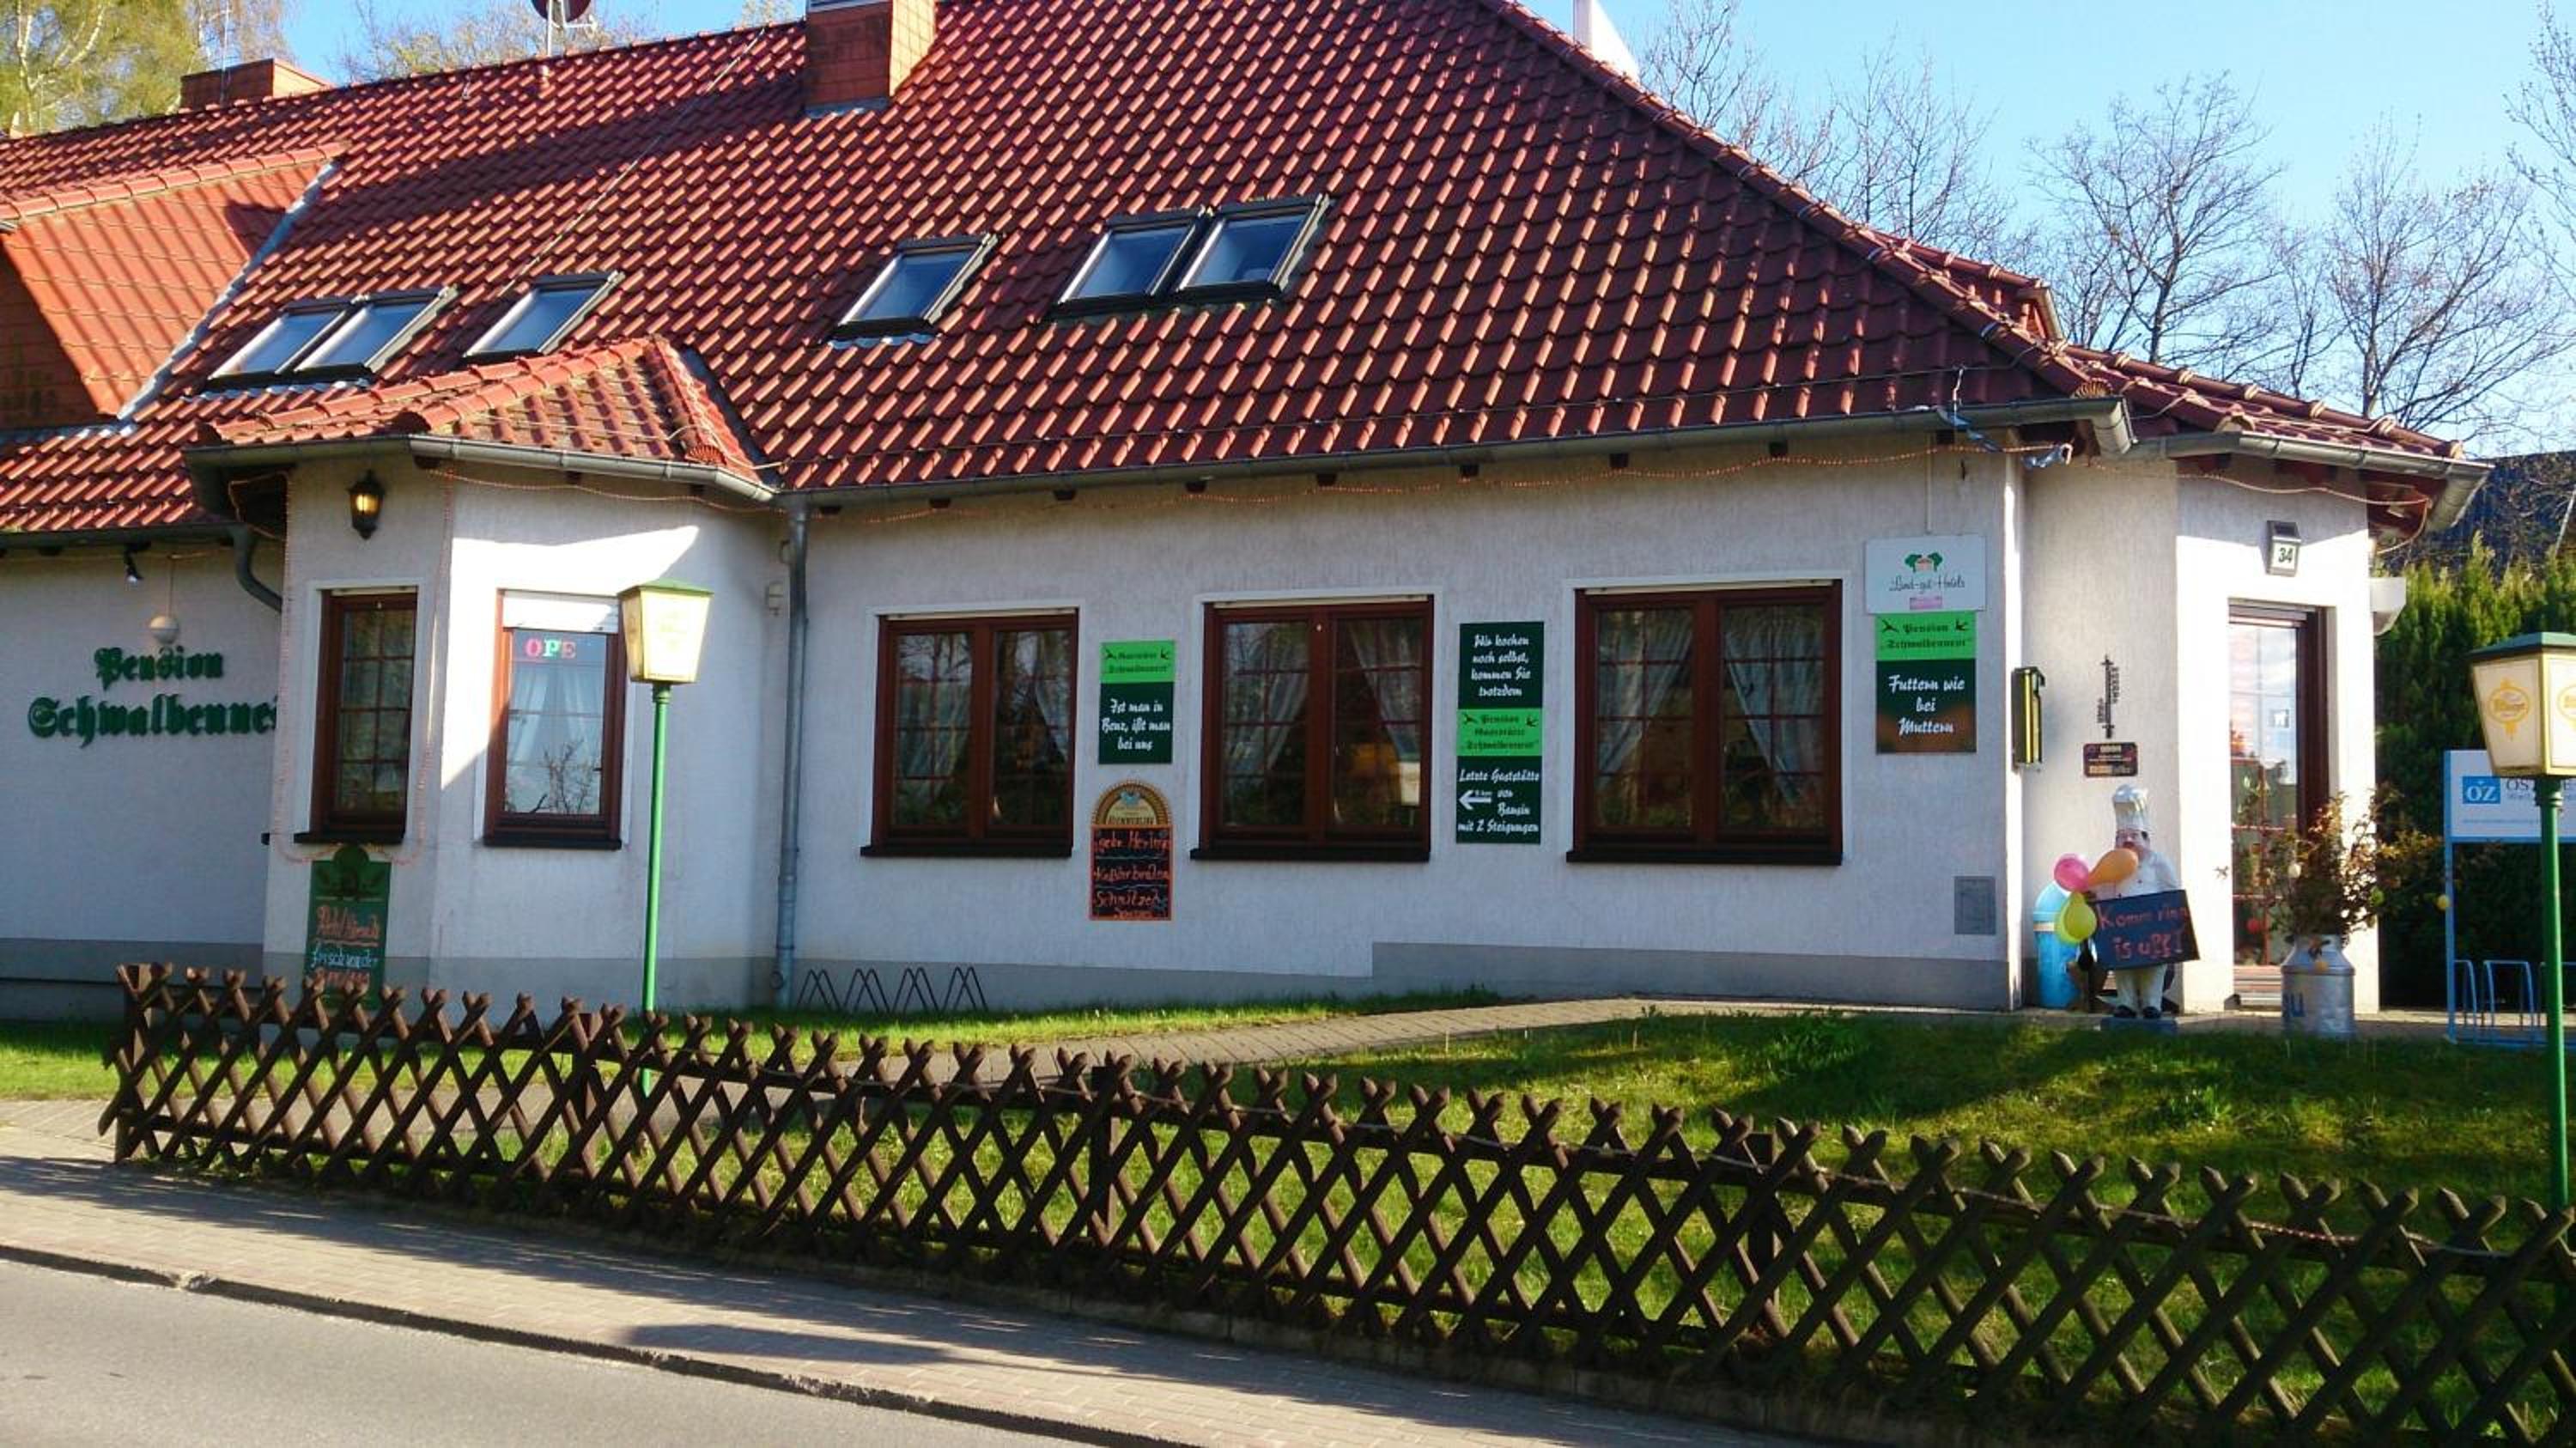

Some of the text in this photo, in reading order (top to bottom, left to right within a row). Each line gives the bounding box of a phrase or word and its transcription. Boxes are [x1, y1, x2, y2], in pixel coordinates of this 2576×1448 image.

[2278, 547, 2294, 563] 34
[94, 646, 223, 691] Pension
[1888, 674, 1965, 694] Futtern wie
[1153, 699, 1163, 712] in
[1916, 697, 1936, 712] bei
[1117, 736, 1133, 750] bei
